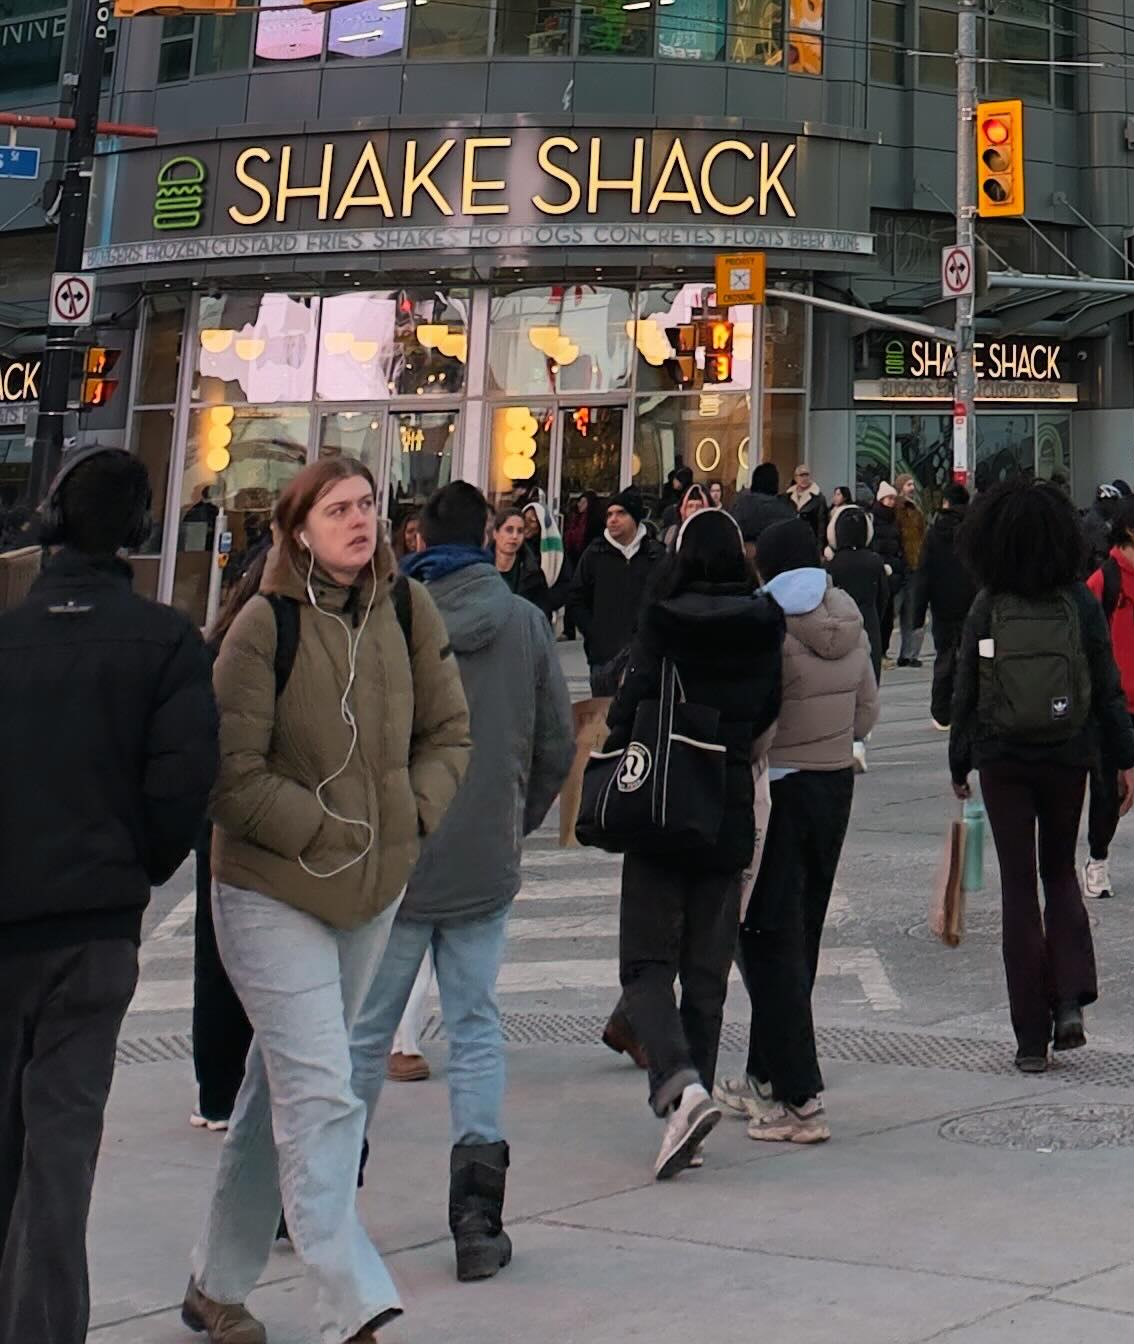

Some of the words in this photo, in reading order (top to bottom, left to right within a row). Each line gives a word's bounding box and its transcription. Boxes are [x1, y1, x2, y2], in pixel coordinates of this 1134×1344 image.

[228, 137, 513, 225] SHAKE
[531, 136, 797, 219] SHACK
[210, 233, 299, 257] CUSTARD
[306, 229, 363, 251] FRIES
[373, 227, 462, 250] SHAKES
[520, 225, 583, 245] DOGS
[593, 224, 717, 245] CONCRETES
[722, 226, 785, 246] FLOATS
[788, 230, 827, 249] BEER
[910, 340, 985, 378] SHAE
[989, 343, 1062, 379] SHACK
